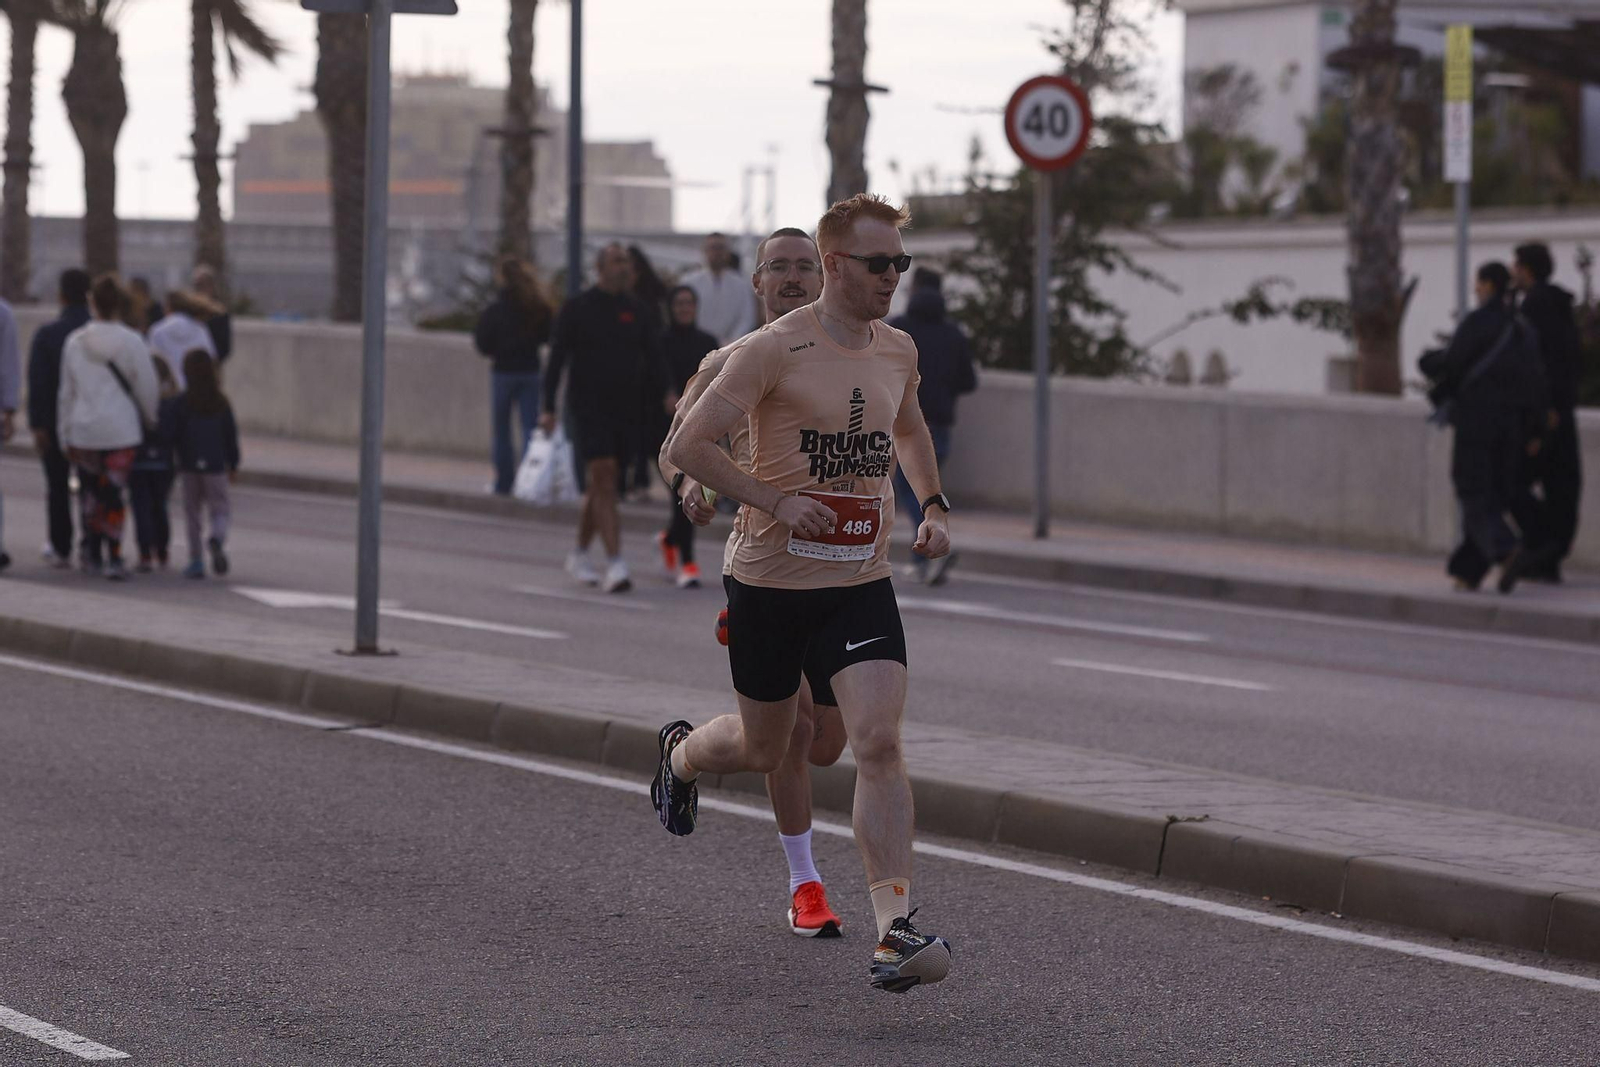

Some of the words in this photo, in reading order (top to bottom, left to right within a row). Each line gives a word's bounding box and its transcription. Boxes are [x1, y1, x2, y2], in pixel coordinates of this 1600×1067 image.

[1024, 102, 1070, 139] 40
[809, 454, 859, 483] RUN
[856, 464, 889, 477] 2025
[843, 520, 872, 535] 486
